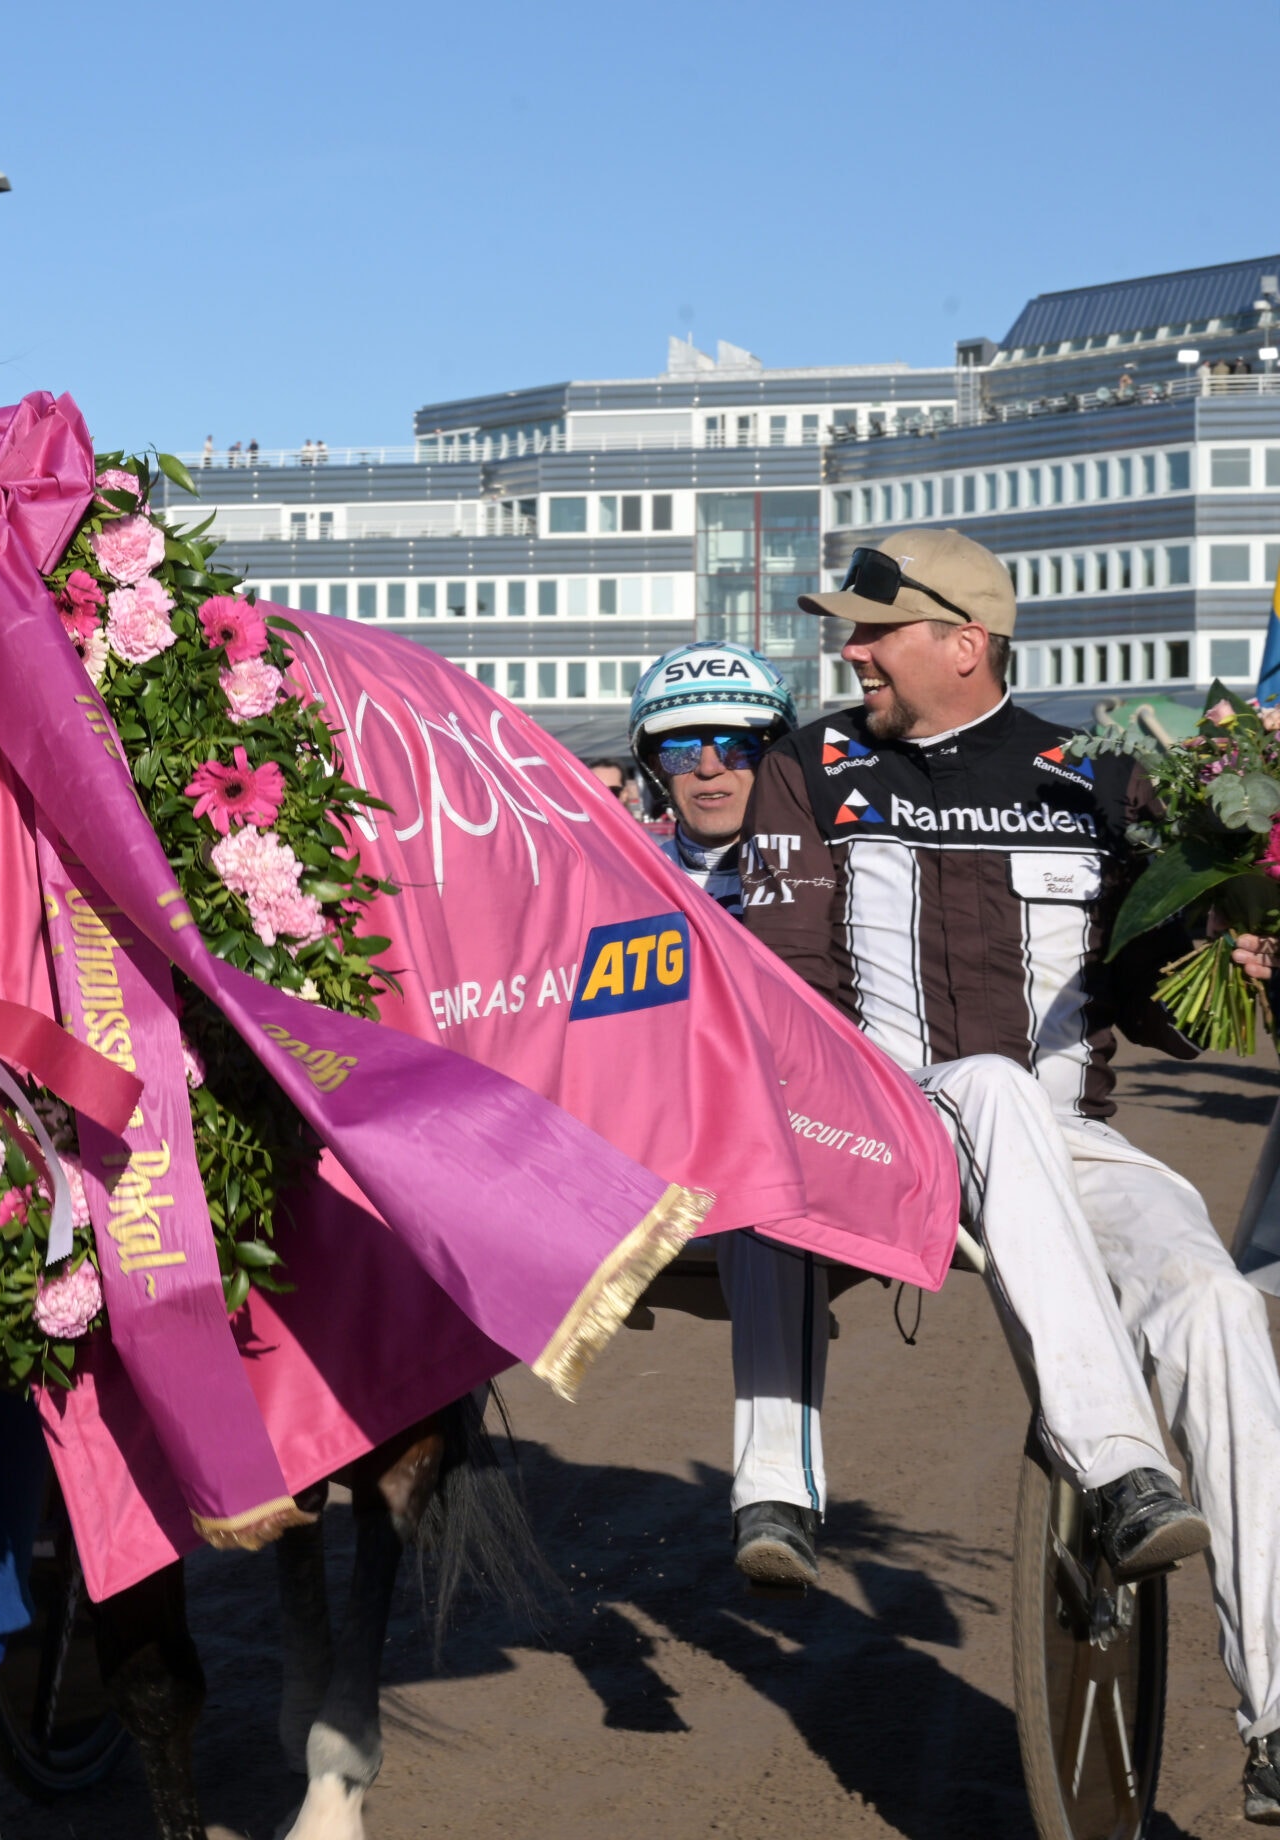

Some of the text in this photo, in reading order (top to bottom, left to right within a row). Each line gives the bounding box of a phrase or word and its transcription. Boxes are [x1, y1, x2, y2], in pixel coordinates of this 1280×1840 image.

[664, 659, 750, 684] SVEA
[1032, 756, 1094, 791] Ramudden
[891, 793, 1097, 838] Ramudden
[1043, 872, 1074, 883] Daniel
[1047, 884, 1073, 893] Redén
[537, 963, 578, 1007] AV
[581, 929, 684, 1001] ATG
[850, 1136, 893, 1165] 2026
[101, 1138, 187, 1278] Pokal
